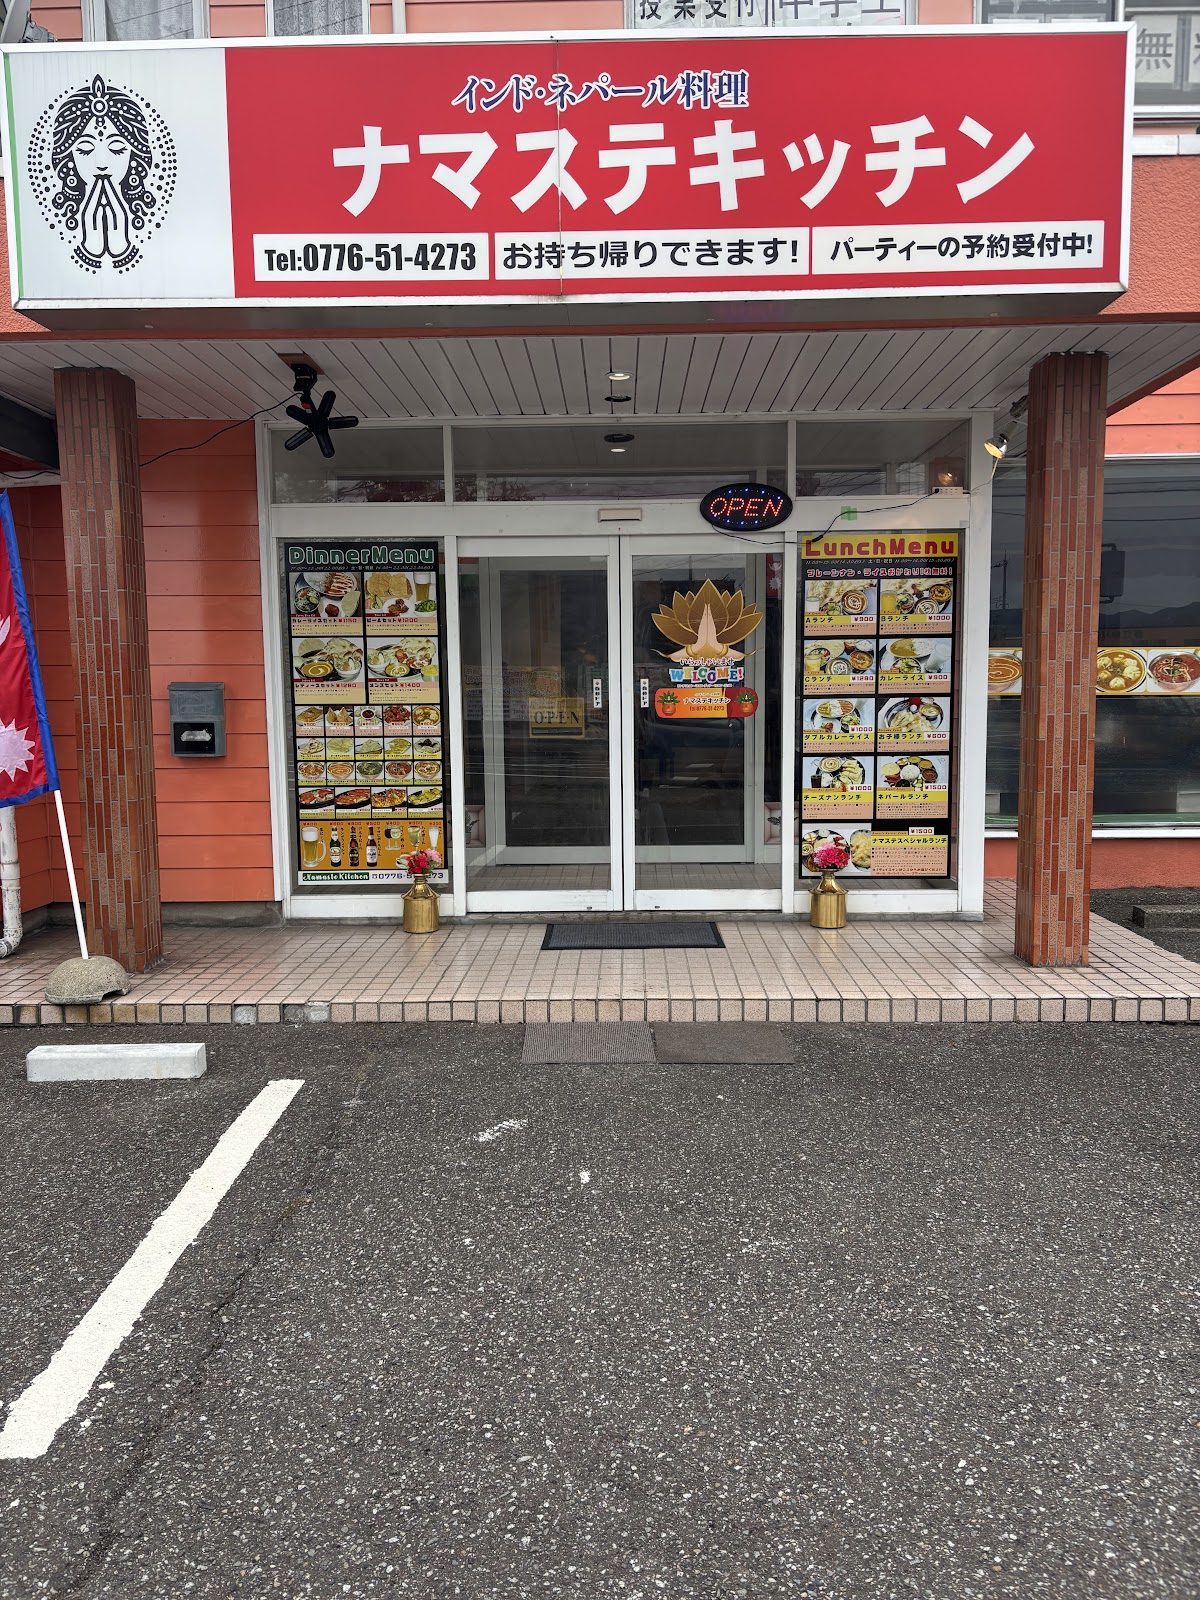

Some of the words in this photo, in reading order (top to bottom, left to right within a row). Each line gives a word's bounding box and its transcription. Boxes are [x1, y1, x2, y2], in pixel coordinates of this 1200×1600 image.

[332, 114, 1036, 218] ナマステキッチン
[264, 242, 477, 272] Tel:0776-51-4273
[502, 237, 800, 272] お持ち帰りできます!
[829, 233, 1094, 262] パーティーの予約受付中!
[709, 497, 784, 517] OPEN
[288, 546, 435, 564] DinnerMenu
[669, 667, 744, 683] WELCOME!
